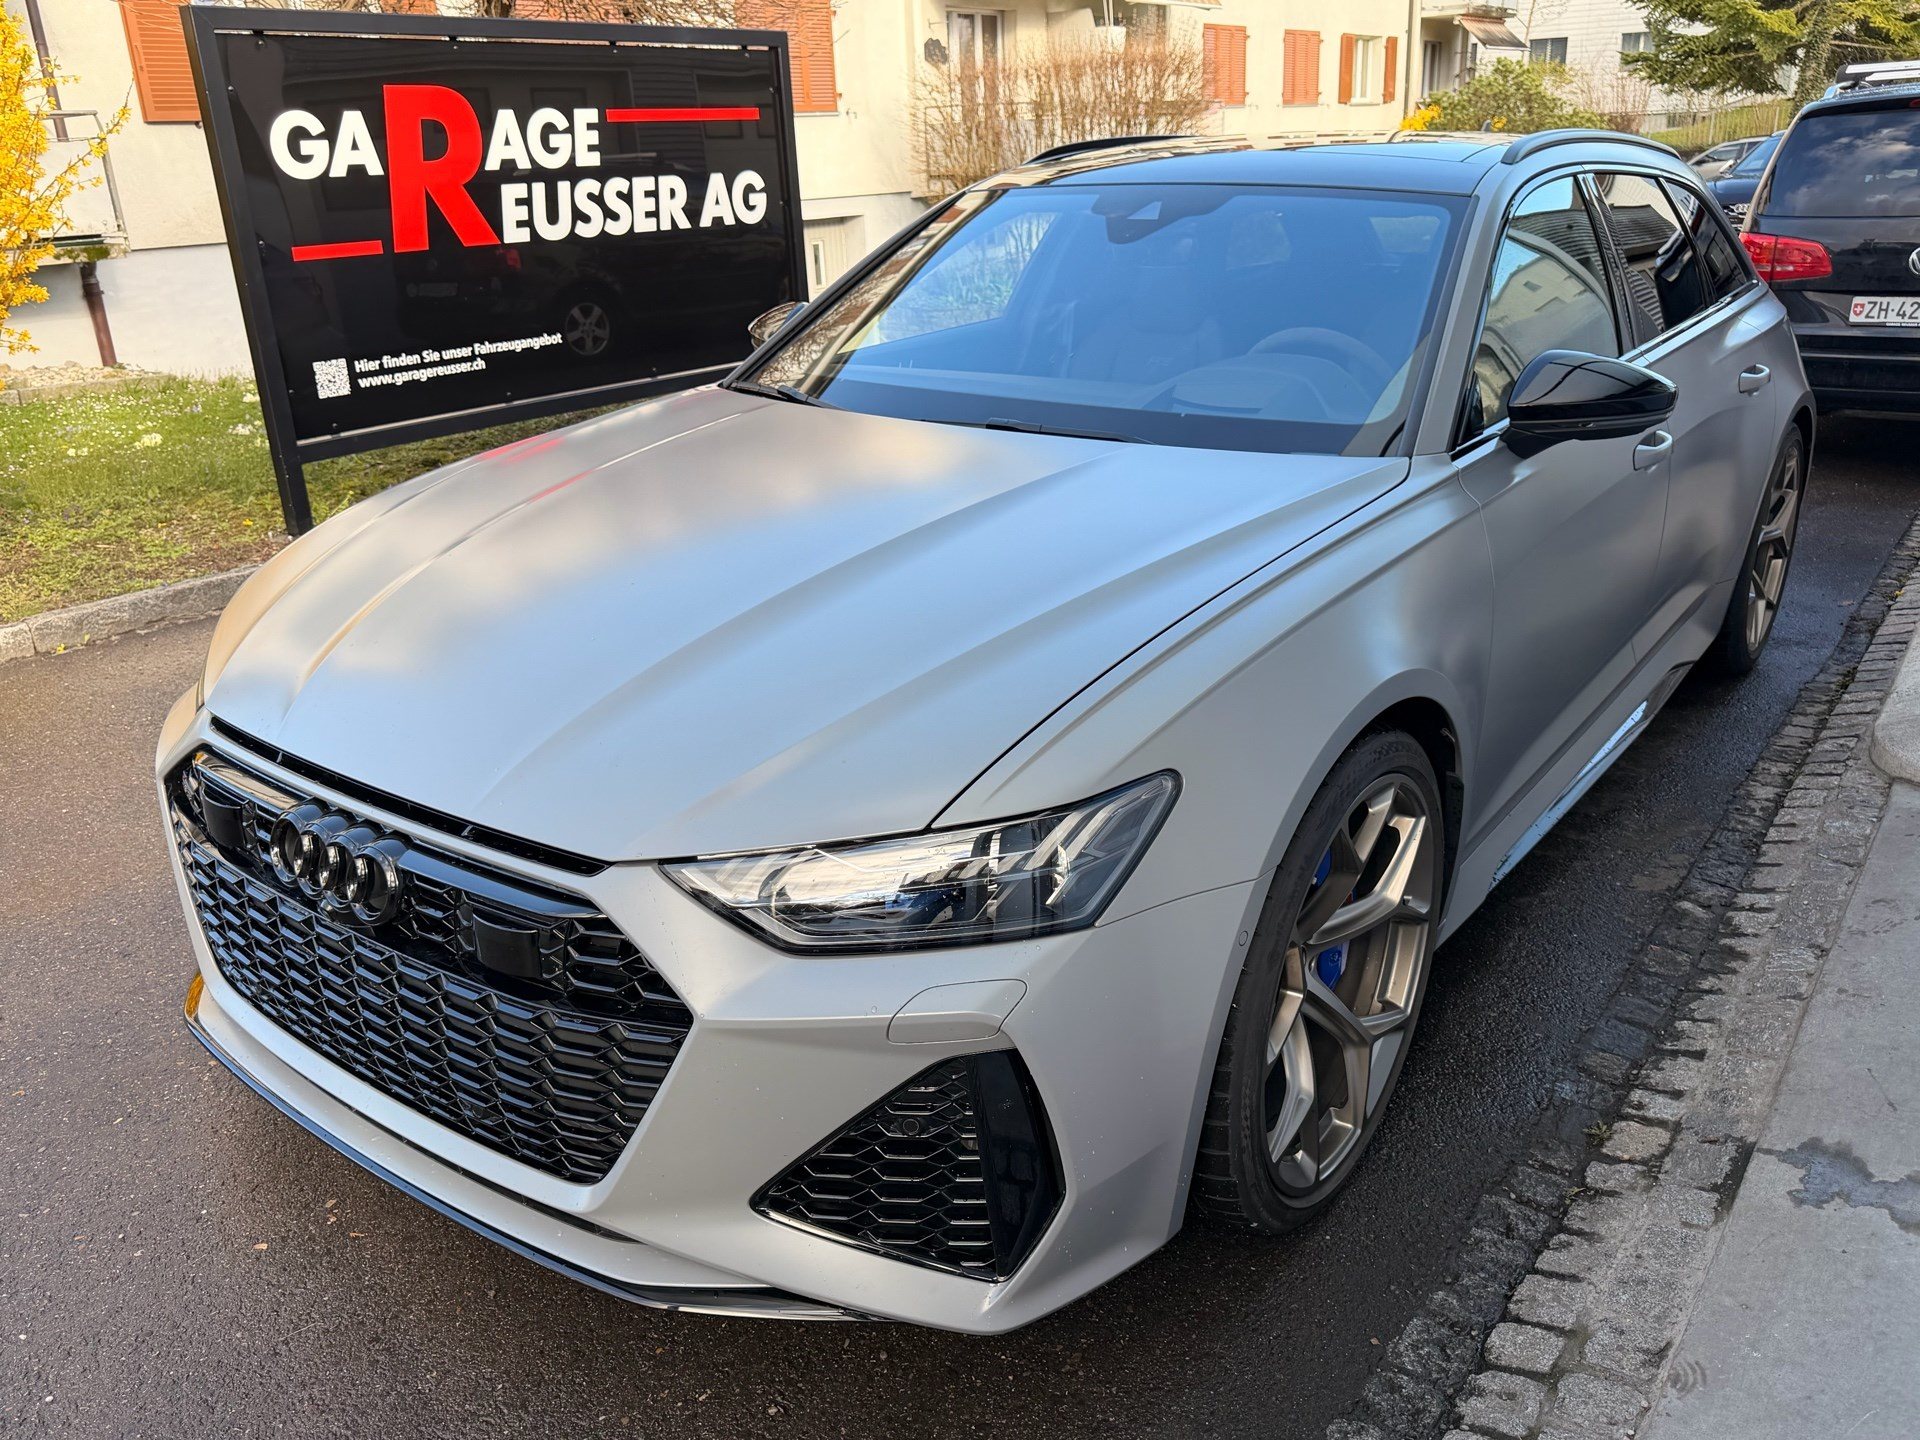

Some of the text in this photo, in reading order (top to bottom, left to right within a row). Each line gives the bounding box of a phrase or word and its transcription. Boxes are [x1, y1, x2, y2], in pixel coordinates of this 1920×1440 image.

[269, 85, 601, 254] GARAGE
[698, 169, 768, 228] AG
[353, 332, 564, 373] Hier finden Sie unser Fahrzeugangebot
[357, 356, 487, 388] www.garagereusser.ch
